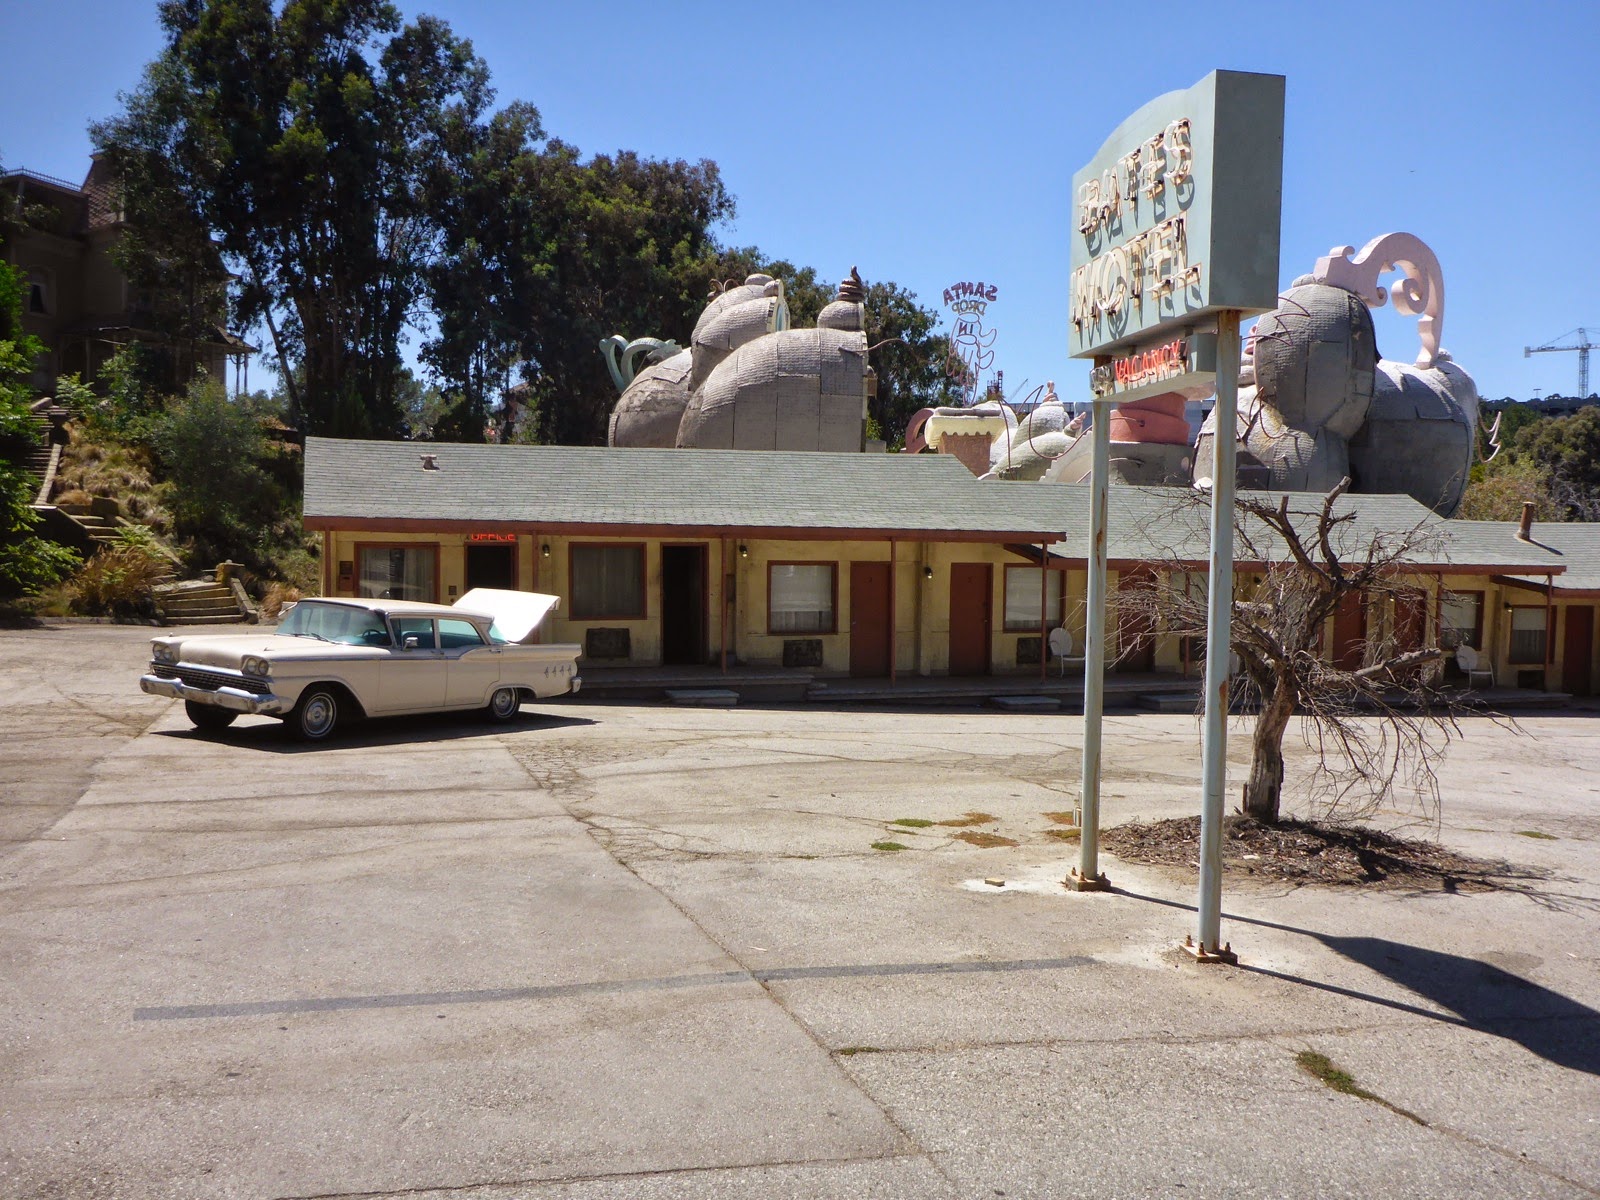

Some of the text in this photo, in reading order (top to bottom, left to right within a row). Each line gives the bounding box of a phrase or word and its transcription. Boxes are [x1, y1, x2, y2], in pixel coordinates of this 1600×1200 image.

[1078, 117, 1193, 236] BATES
[1070, 211, 1202, 332] MOTEL
[1114, 339, 1185, 387] VACANCY
